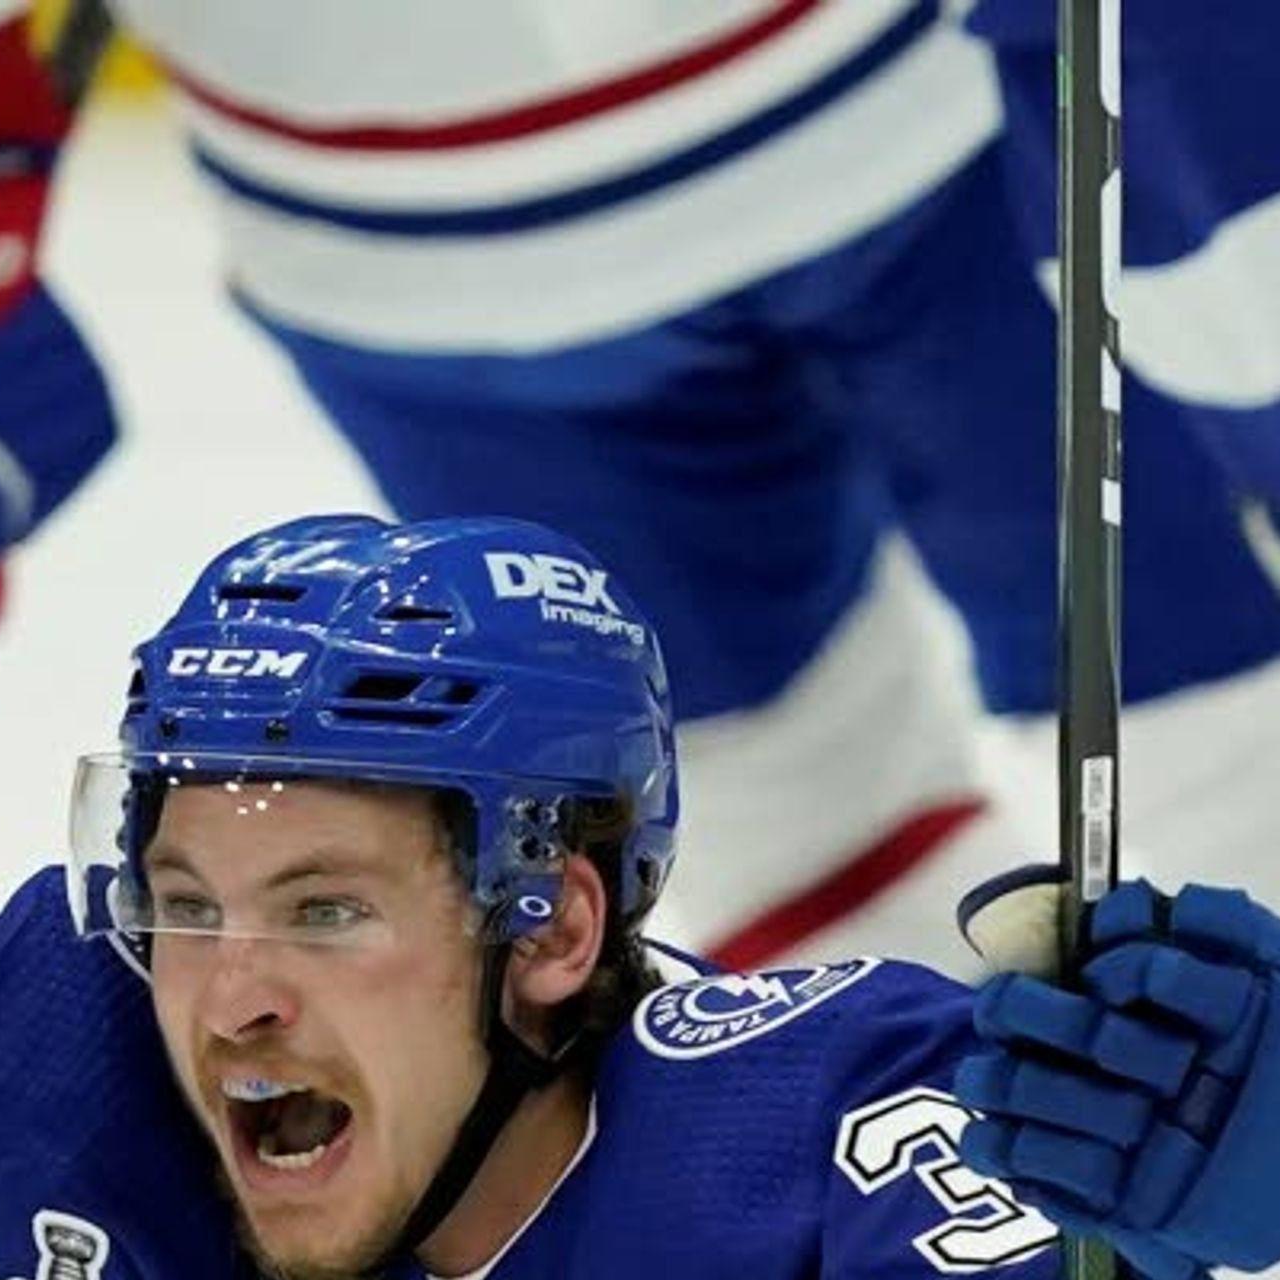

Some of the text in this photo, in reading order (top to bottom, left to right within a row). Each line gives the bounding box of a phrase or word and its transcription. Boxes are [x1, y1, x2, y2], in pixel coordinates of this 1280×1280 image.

[484, 553, 622, 616] DEX
[167, 649, 309, 678] CCM
[668, 1010, 767, 1044] TAMPA
